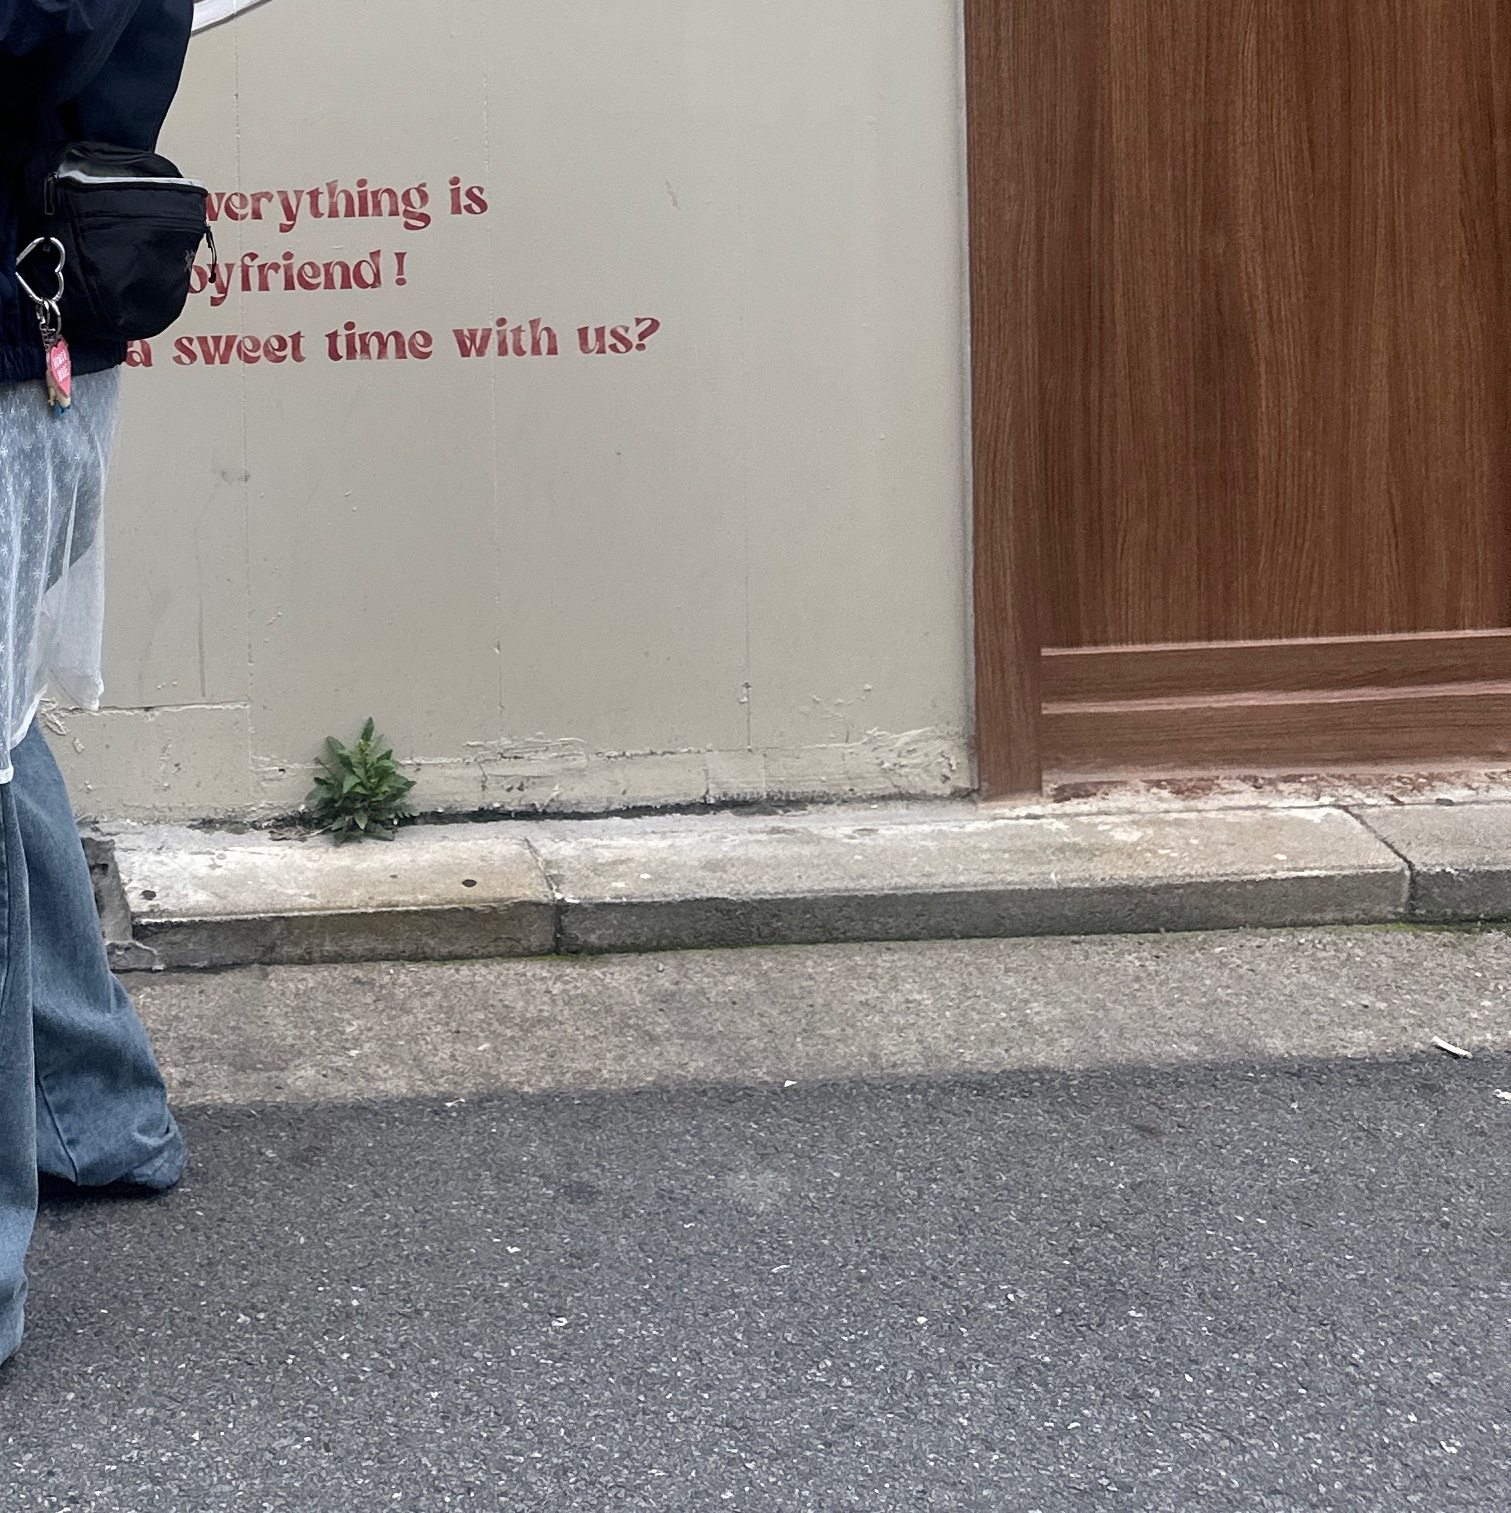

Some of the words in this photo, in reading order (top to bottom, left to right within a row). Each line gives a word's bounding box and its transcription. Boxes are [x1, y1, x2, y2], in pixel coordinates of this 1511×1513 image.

[204, 177, 432, 230] verything
[449, 176, 489, 215] is
[188, 249, 382, 306] oyfriend
[172, 331, 306, 366] sweet
[325, 321, 434, 362] time
[452, 317, 559, 358] with
[577, 317, 661, 355] us?
